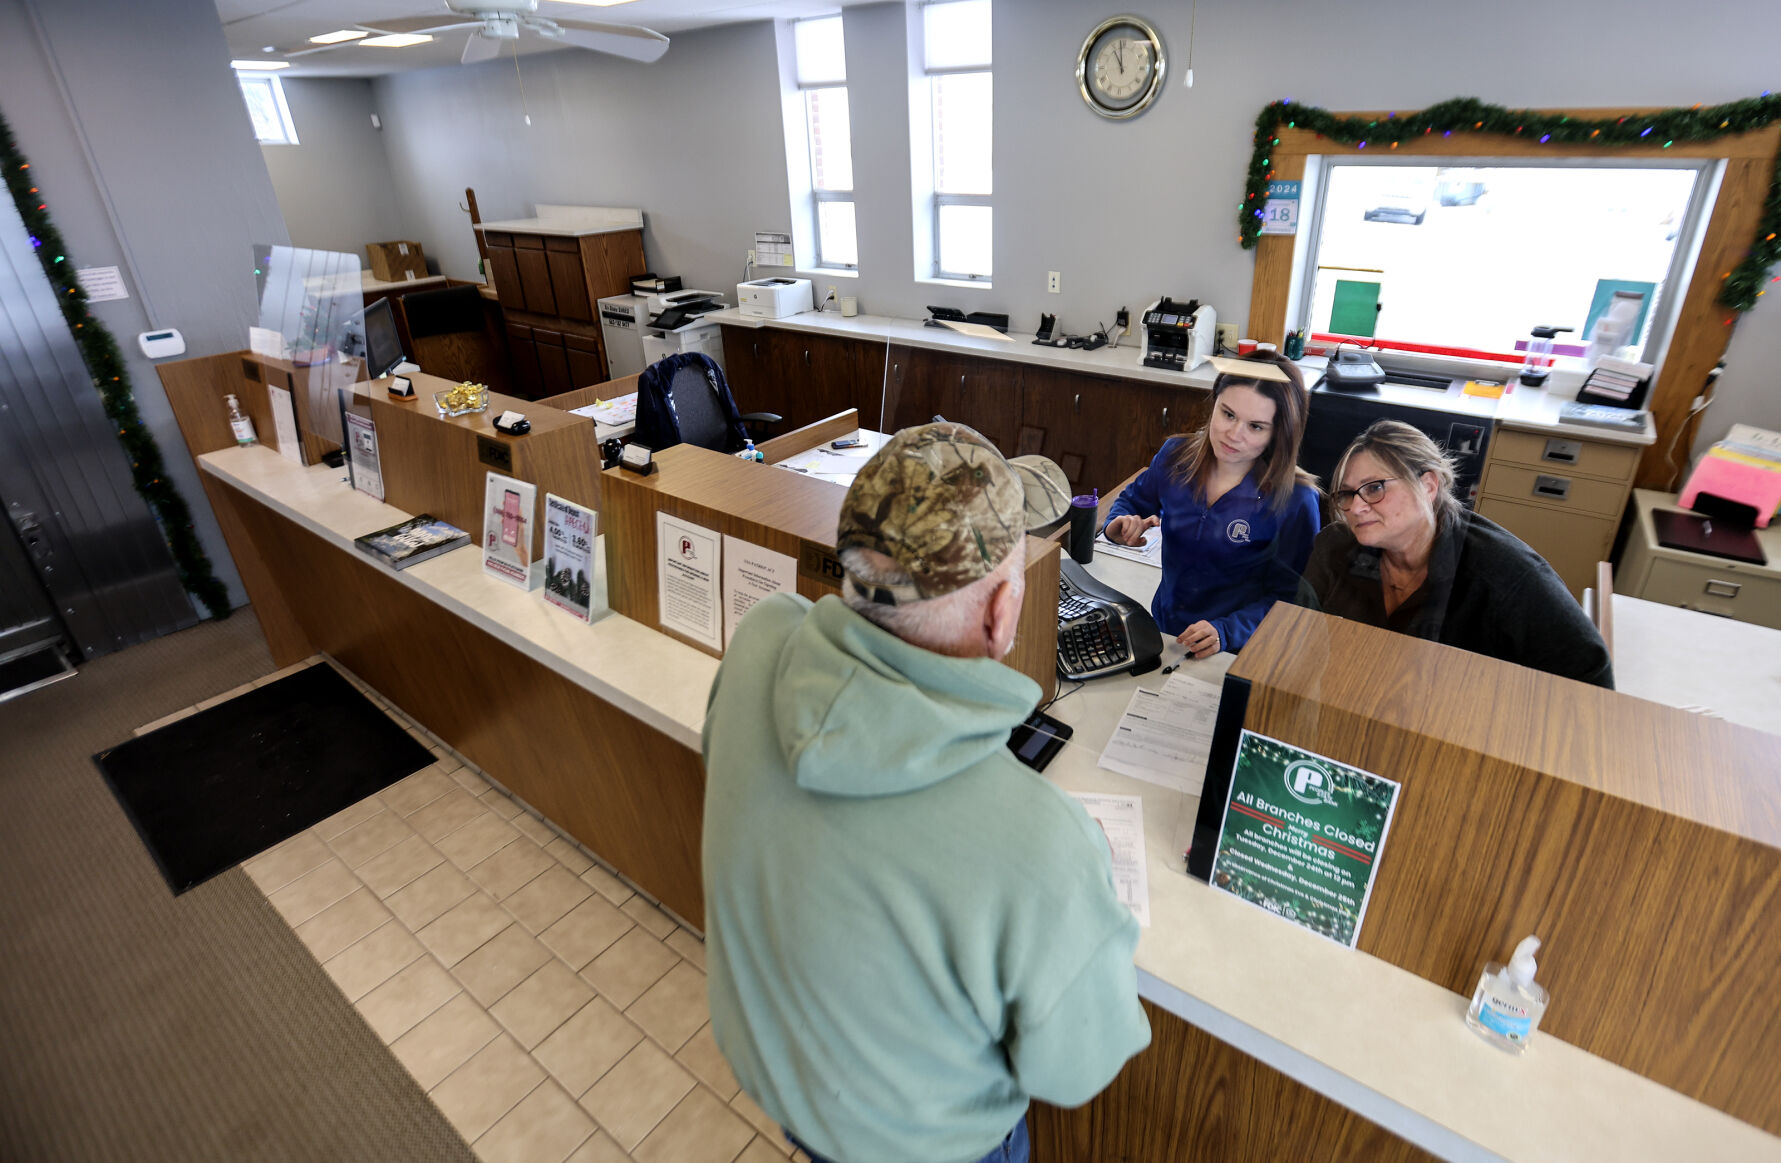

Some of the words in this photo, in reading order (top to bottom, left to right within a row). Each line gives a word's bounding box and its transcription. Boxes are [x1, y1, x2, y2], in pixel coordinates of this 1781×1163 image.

[1269, 184, 1297, 193] 2024
[1269, 207, 1291, 221] 18
[823, 558, 844, 578] FD
[1236, 789, 1254, 805] All
[1255, 797, 1321, 832] Branches
[1322, 822, 1376, 853] Closed
[1286, 823, 1308, 838] Merry
[1234, 832, 1267, 853] Tuesday,
[1267, 846, 1307, 868] December
[1243, 828, 1253, 838] All
[1253, 832, 1288, 852] branches
[1287, 846, 1302, 857] will
[1301, 852, 1312, 862] be
[1311, 856, 1341, 875] closing
[1340, 868, 1352, 878] on
[1261, 821, 1336, 861] Christmas
[1228, 846, 1254, 863] Closed
[1252, 856, 1298, 883] Wednesday,
[1297, 876, 1337, 899] December
